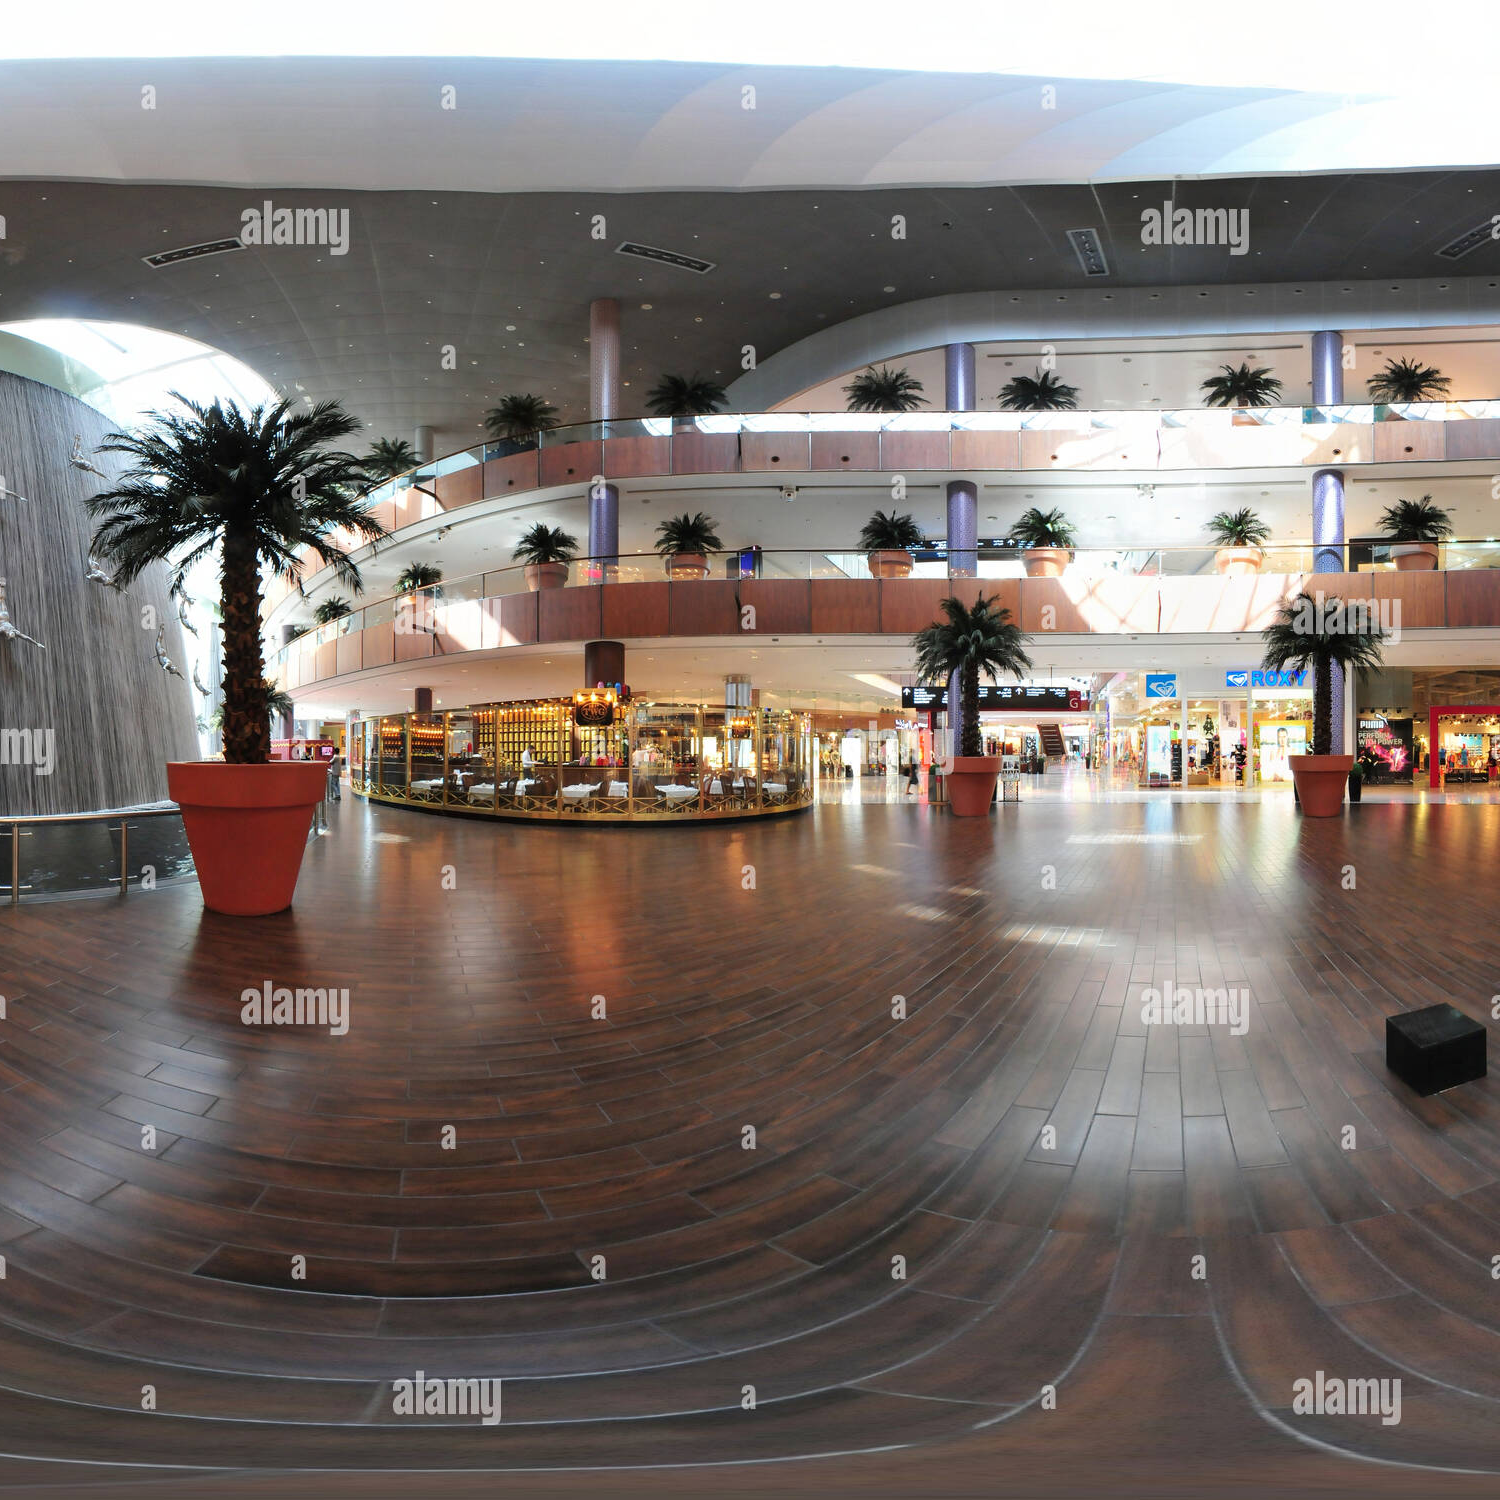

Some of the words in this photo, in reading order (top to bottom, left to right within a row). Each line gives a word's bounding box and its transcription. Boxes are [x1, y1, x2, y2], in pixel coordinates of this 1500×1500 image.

[1251, 670, 1308, 687] ROXY
[1069, 697, 1079, 709] G
[1360, 720, 1385, 729] PUMA
[1358, 732, 1391, 740] PERFORM
